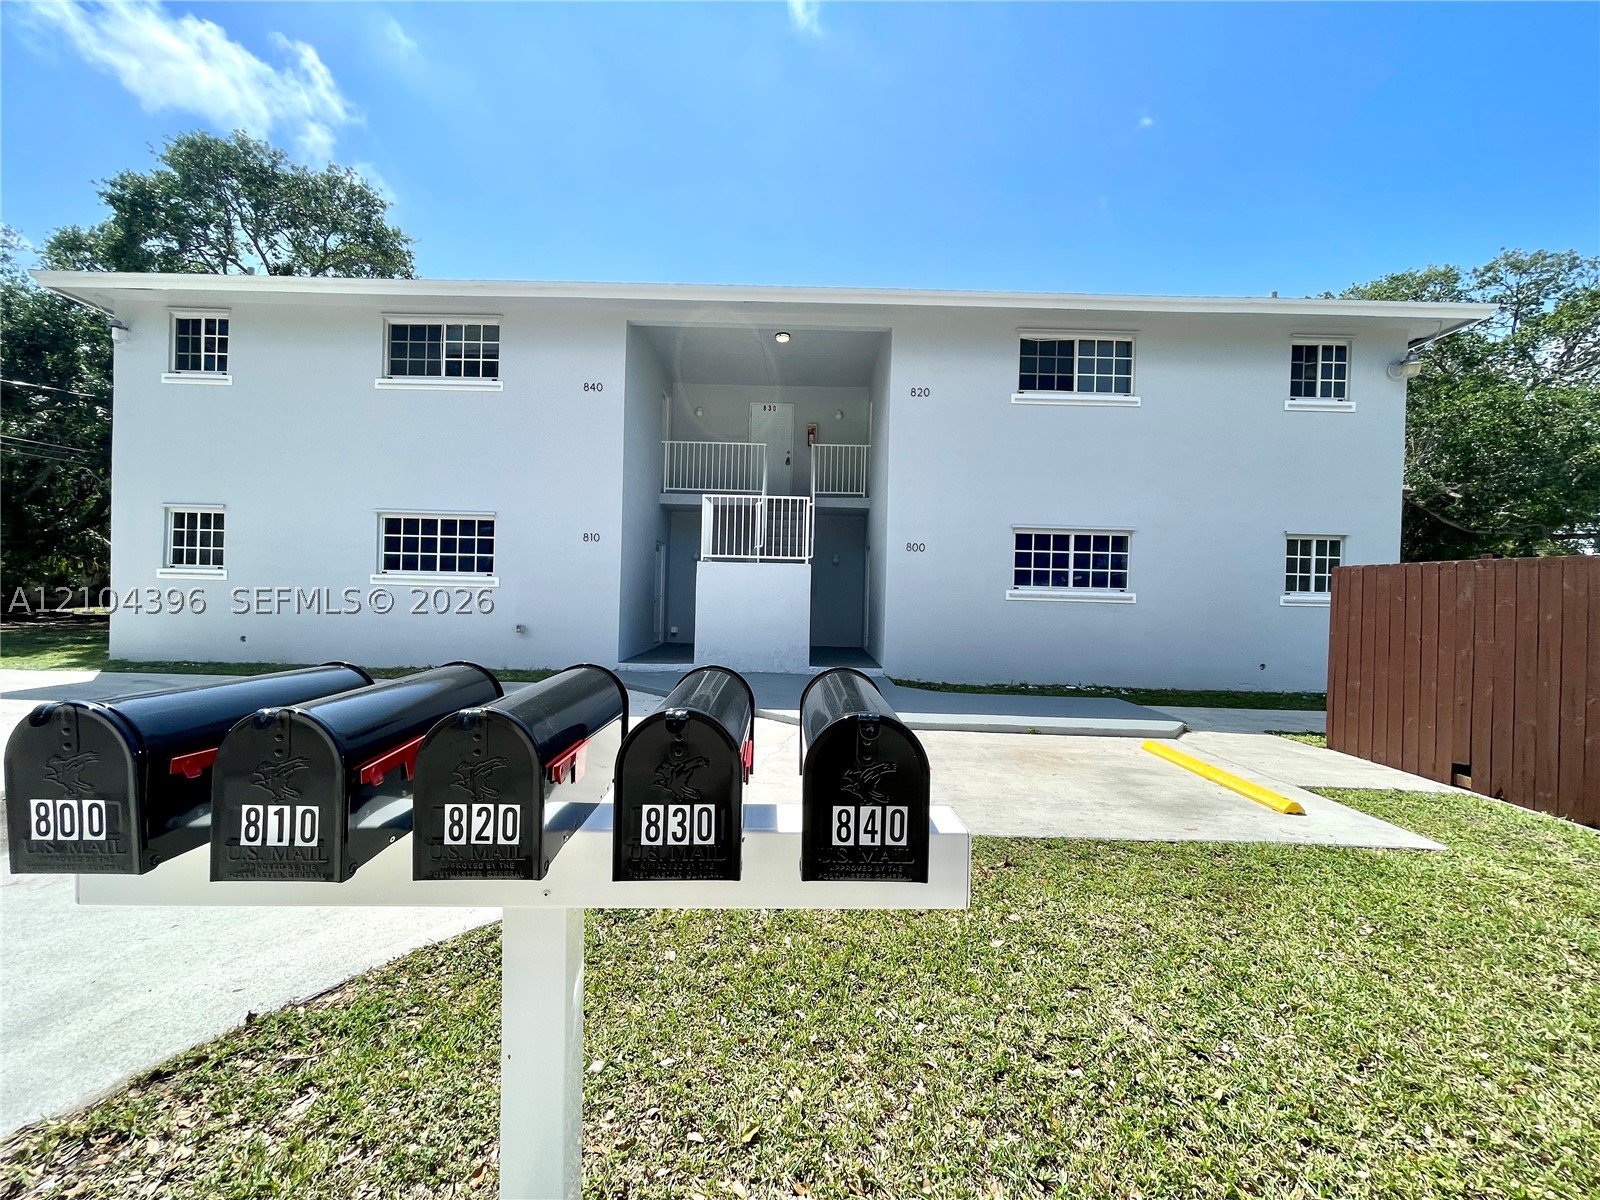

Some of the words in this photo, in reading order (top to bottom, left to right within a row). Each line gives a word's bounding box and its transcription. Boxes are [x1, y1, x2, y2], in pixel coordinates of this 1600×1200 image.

[583, 382, 603, 392] 840
[910, 387, 930, 397] 820
[762, 404, 777, 412] 830
[582, 532, 600, 542] 810
[905, 542, 926, 552] 800
[34, 801, 105, 838] 800
[243, 806, 317, 844] 810
[448, 806, 520, 842] 820
[645, 806, 713, 843] 830
[836, 808, 905, 844] 840
[270, 846, 329, 863] MAIL
[428, 845, 463, 861] U.S.
[469, 845, 526, 861] MAIL
[669, 845, 726, 861] MAIL
[499, 862, 515, 870] THE
